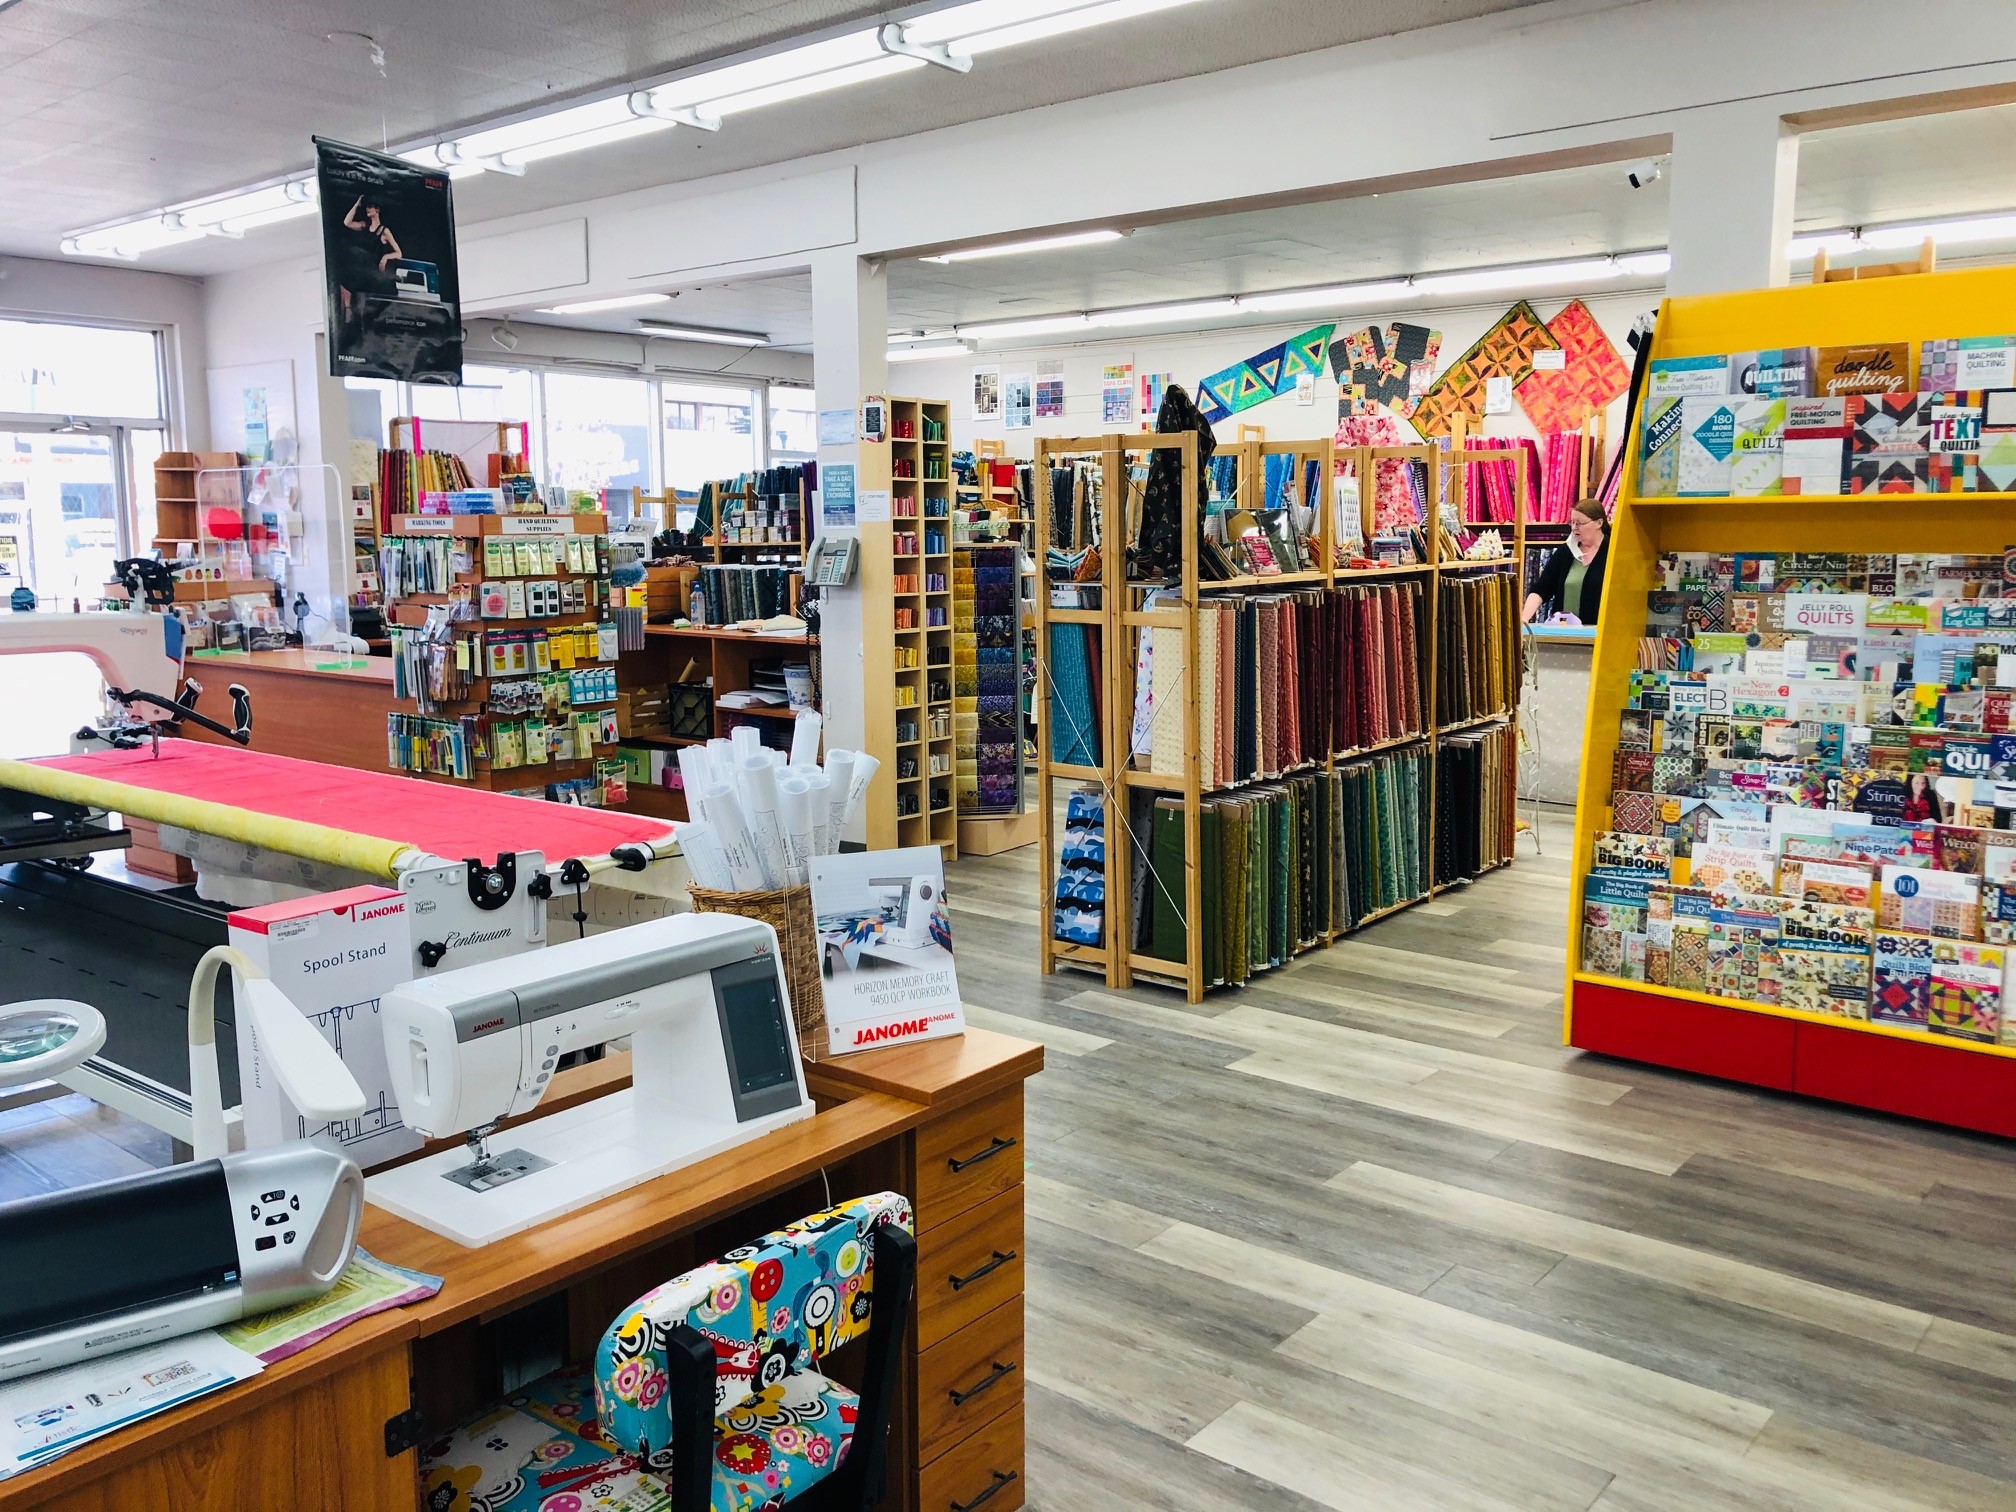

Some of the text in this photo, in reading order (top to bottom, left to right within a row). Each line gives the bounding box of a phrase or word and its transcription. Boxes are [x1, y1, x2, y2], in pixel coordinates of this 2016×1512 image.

[1967, 351, 2006, 360] MACHINE
[1834, 351, 1895, 374] doodle
[1966, 360, 2006, 370] QUILTING
[1746, 367, 1806, 386] QUILTING
[1827, 366, 1904, 397] quilting
[1681, 384, 1702, 392] Quilting
[1651, 402, 1684, 436] Making
[1712, 415, 1733, 424] 180
[1790, 418, 1826, 426] QUILTING
[1931, 418, 1982, 440] TEXT
[1742, 437, 1784, 449] QUILT
[1782, 560, 1812, 569] Circle
[1813, 561, 1823, 569] of
[1872, 584, 1894, 592] BLO
[1799, 603, 1826, 611] JELLY
[1797, 612, 1854, 625] QUILTS
[1698, 639, 1710, 649] 25
[1864, 639, 1889, 647] Little
[1674, 693, 1706, 702] ELECT
[1733, 687, 1777, 697] Hexagon
[1800, 722, 1821, 738] RED
[1776, 737, 1798, 745] Royal
[1945, 743, 1978, 753] Simple
[1946, 752, 1991, 771] QUI
[1867, 789, 1906, 806] String
[1730, 805, 1752, 814] Trendy
[1845, 843, 1872, 853] Nine
[1599, 854, 1667, 870] BIG BOOK
[1705, 854, 1757, 868] Strip Quilts
[1600, 886, 1622, 895] Little
[1898, 879, 1915, 893] 101
[361, 903, 405, 921] JANOME
[1678, 903, 1695, 914] Lap
[445, 927, 512, 949] Continuum
[1786, 925, 1871, 945] BIG BOOK
[303, 943, 386, 974] Spool Stand
[1882, 960, 1905, 969] Quilt
[1890, 969, 1928, 979] Builder
[1941, 970, 1966, 979] Block
[853, 970, 949, 995] HORIZON MEMORY CRAFT
[870, 984, 952, 1007] 9450 QCP WORKBOOK
[472, 1018, 505, 1033] JANOME
[853, 1017, 928, 1045] JANOME
